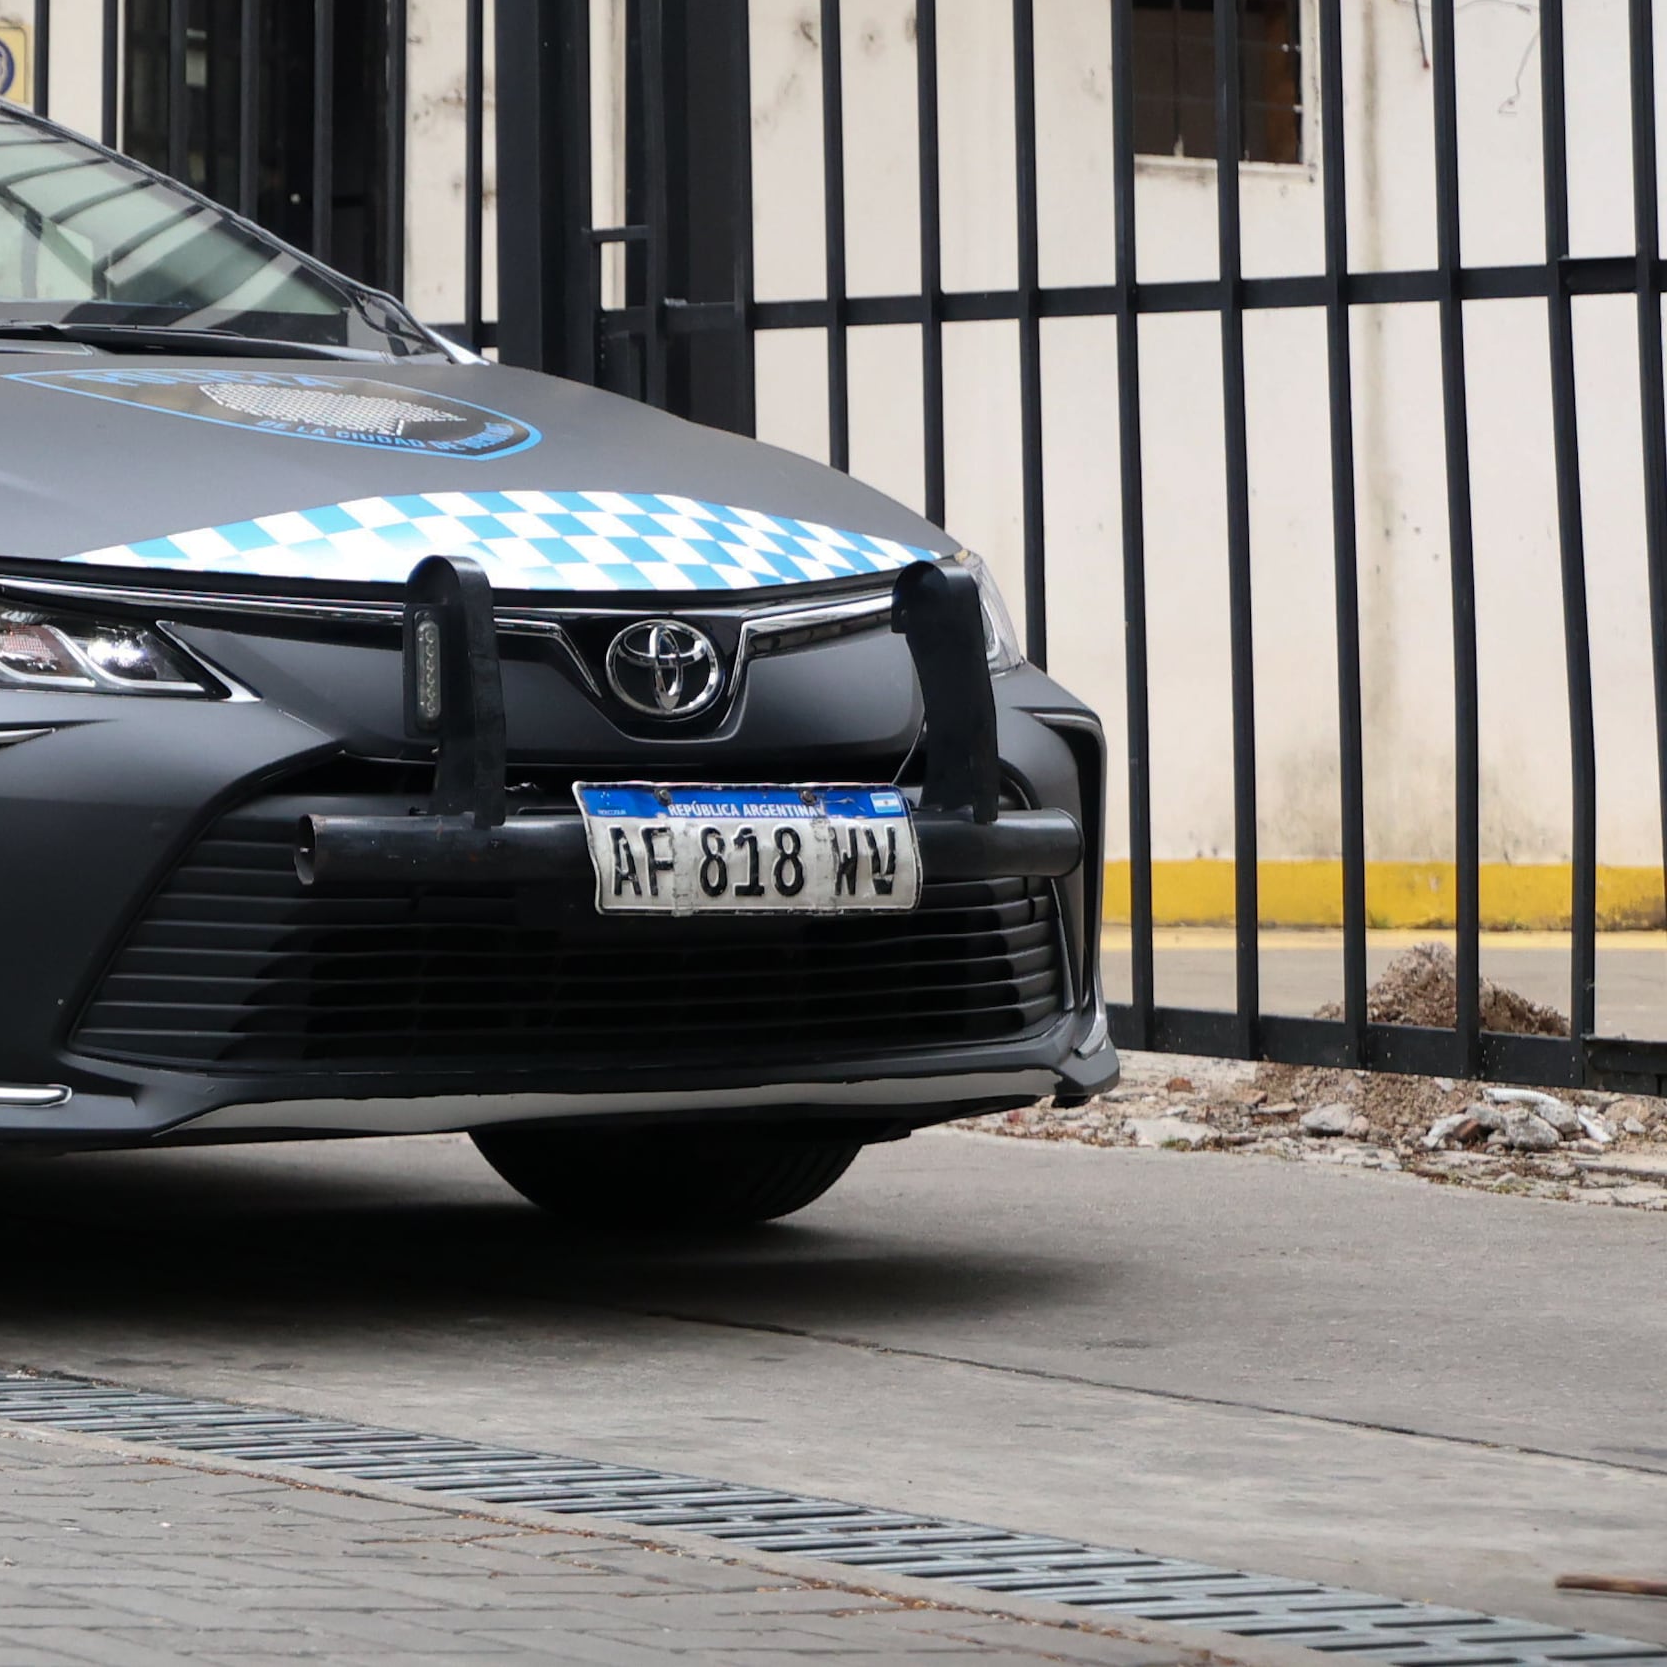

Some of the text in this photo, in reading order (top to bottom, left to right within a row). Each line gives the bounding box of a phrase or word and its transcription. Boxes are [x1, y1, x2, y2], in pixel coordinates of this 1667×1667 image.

[667, 801, 818, 817] REPÚBLICA ARGENTINA
[608, 826, 674, 896] AF
[700, 826, 804, 897] 818
